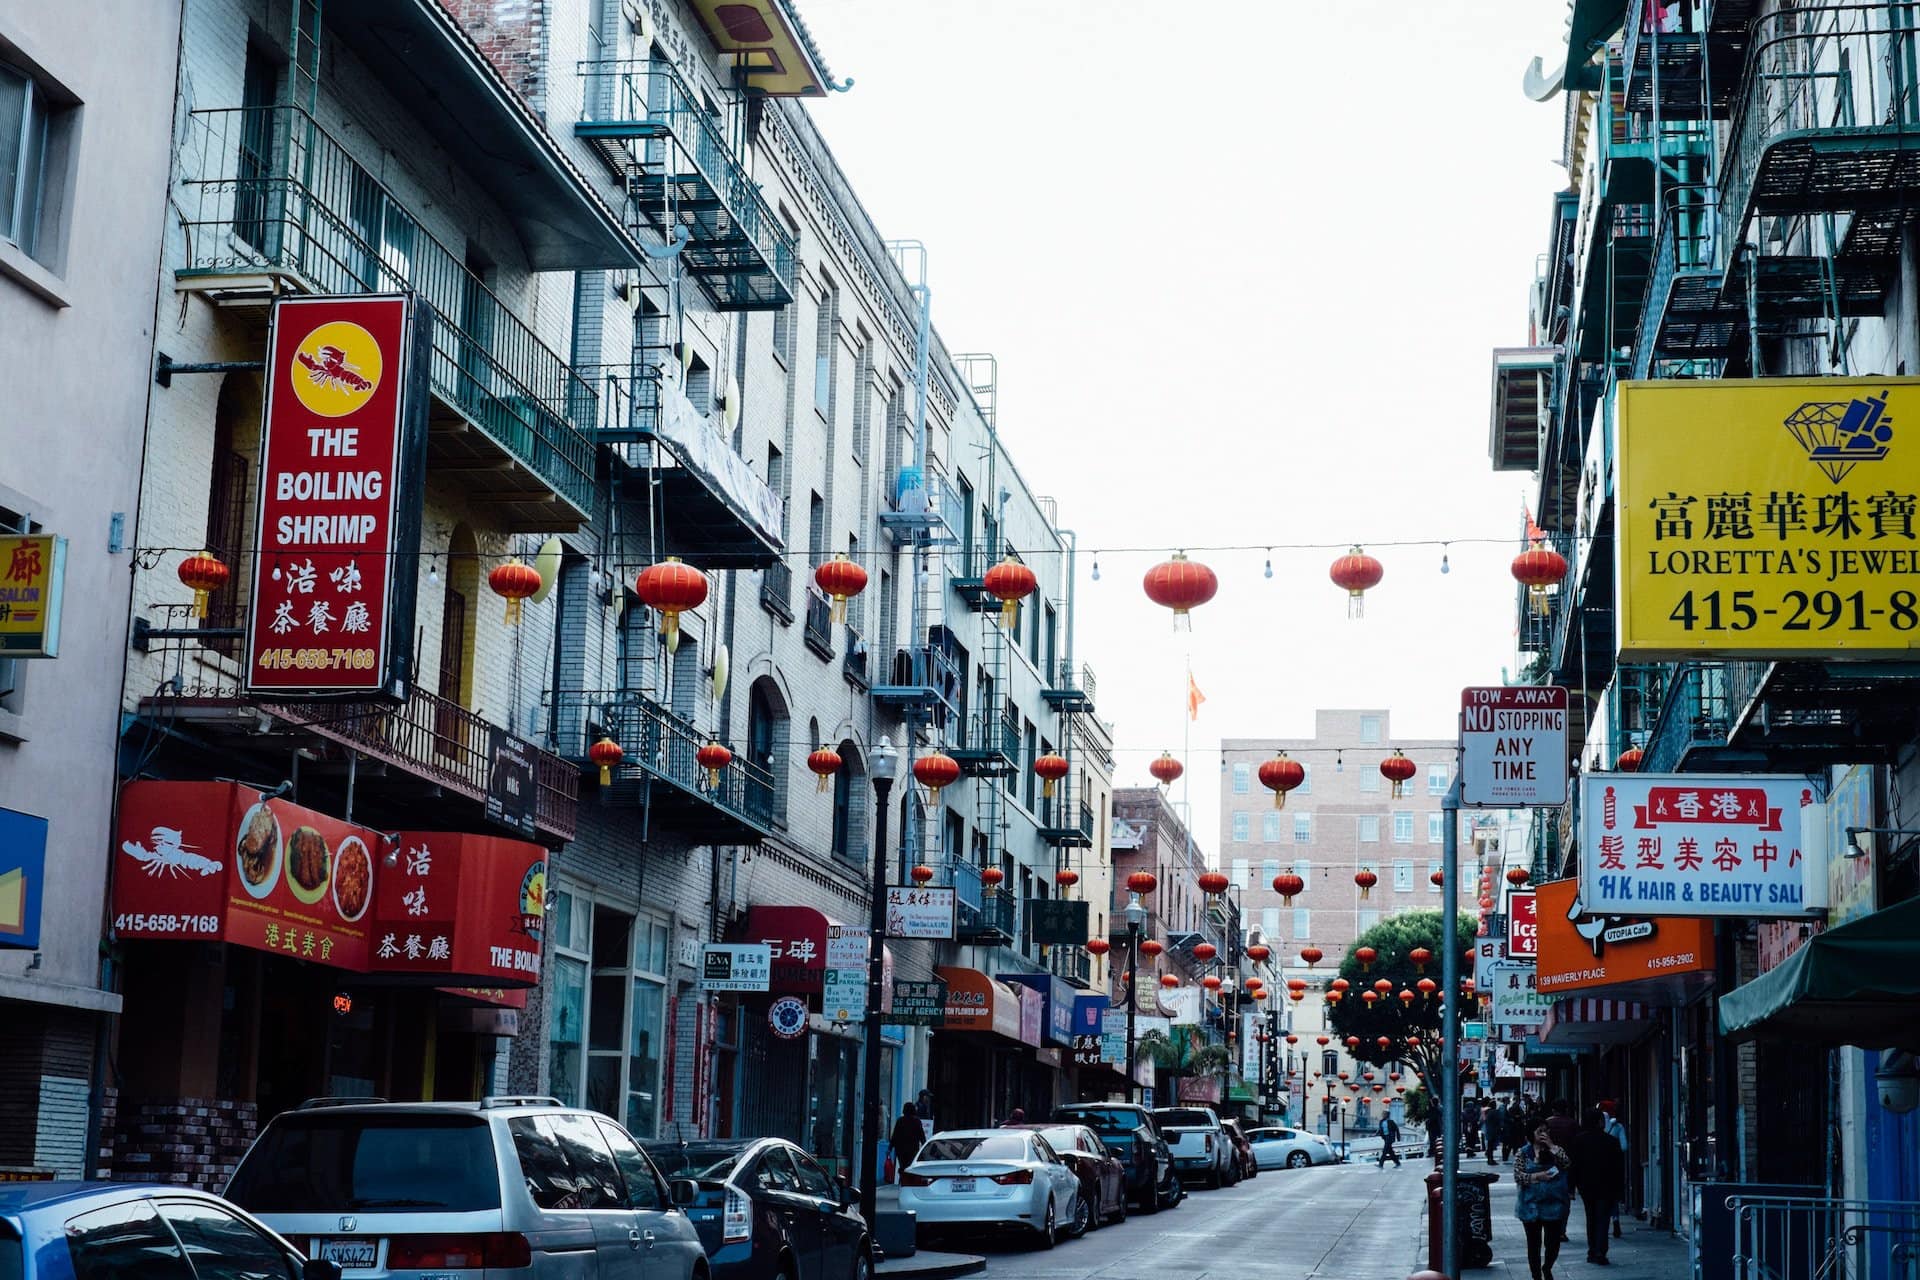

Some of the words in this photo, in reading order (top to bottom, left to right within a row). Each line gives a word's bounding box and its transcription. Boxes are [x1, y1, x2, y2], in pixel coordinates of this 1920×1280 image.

[307, 428, 359, 457] THE
[276, 471, 382, 501] BOILING
[1648, 490, 1918, 541] 富麗華珠寶
[276, 515, 377, 545] SHRIMP
[1648, 549, 1821, 575] LORETTA'S
[286, 558, 362, 594] 浩味
[269, 600, 372, 636] 茶餐廳
[1669, 590, 1919, 631] 415-291-8
[259, 648, 376, 670] 415-658-7168
[1465, 705, 1492, 731] NO
[1498, 711, 1562, 731] STOPPING
[1495, 737, 1533, 756] ANY
[1492, 761, 1536, 780] TIME
[1674, 792, 1742, 819] 香港
[402, 843, 432, 916] 浩味
[1638, 882, 1676, 901] HAIR
[1682, 882, 1694, 901] &
[1700, 882, 1763, 903] BEAUTY
[1769, 884, 1803, 904] SAL
[115, 914, 218, 932] 415-658-7168
[828, 927, 840, 938] NO
[1607, 928, 1632, 941] UTOPIA
[1633, 925, 1649, 936] Cafe
[265, 923, 334, 960] 港式美食
[376, 933, 451, 960] 茶餐廳
[490, 946, 512, 968] THE
[1647, 953, 1694, 968] 415-956-2902
[828, 973, 836, 984] 2
[1540, 975, 1551, 986] 139
[1551, 970, 1582, 984] WAVERLY
[1583, 968, 1605, 979] PLACE
[334, 996, 351, 1012] OPEN
[906, 998, 935, 1007] CENTER
[915, 1007, 944, 1016] AGENCY
